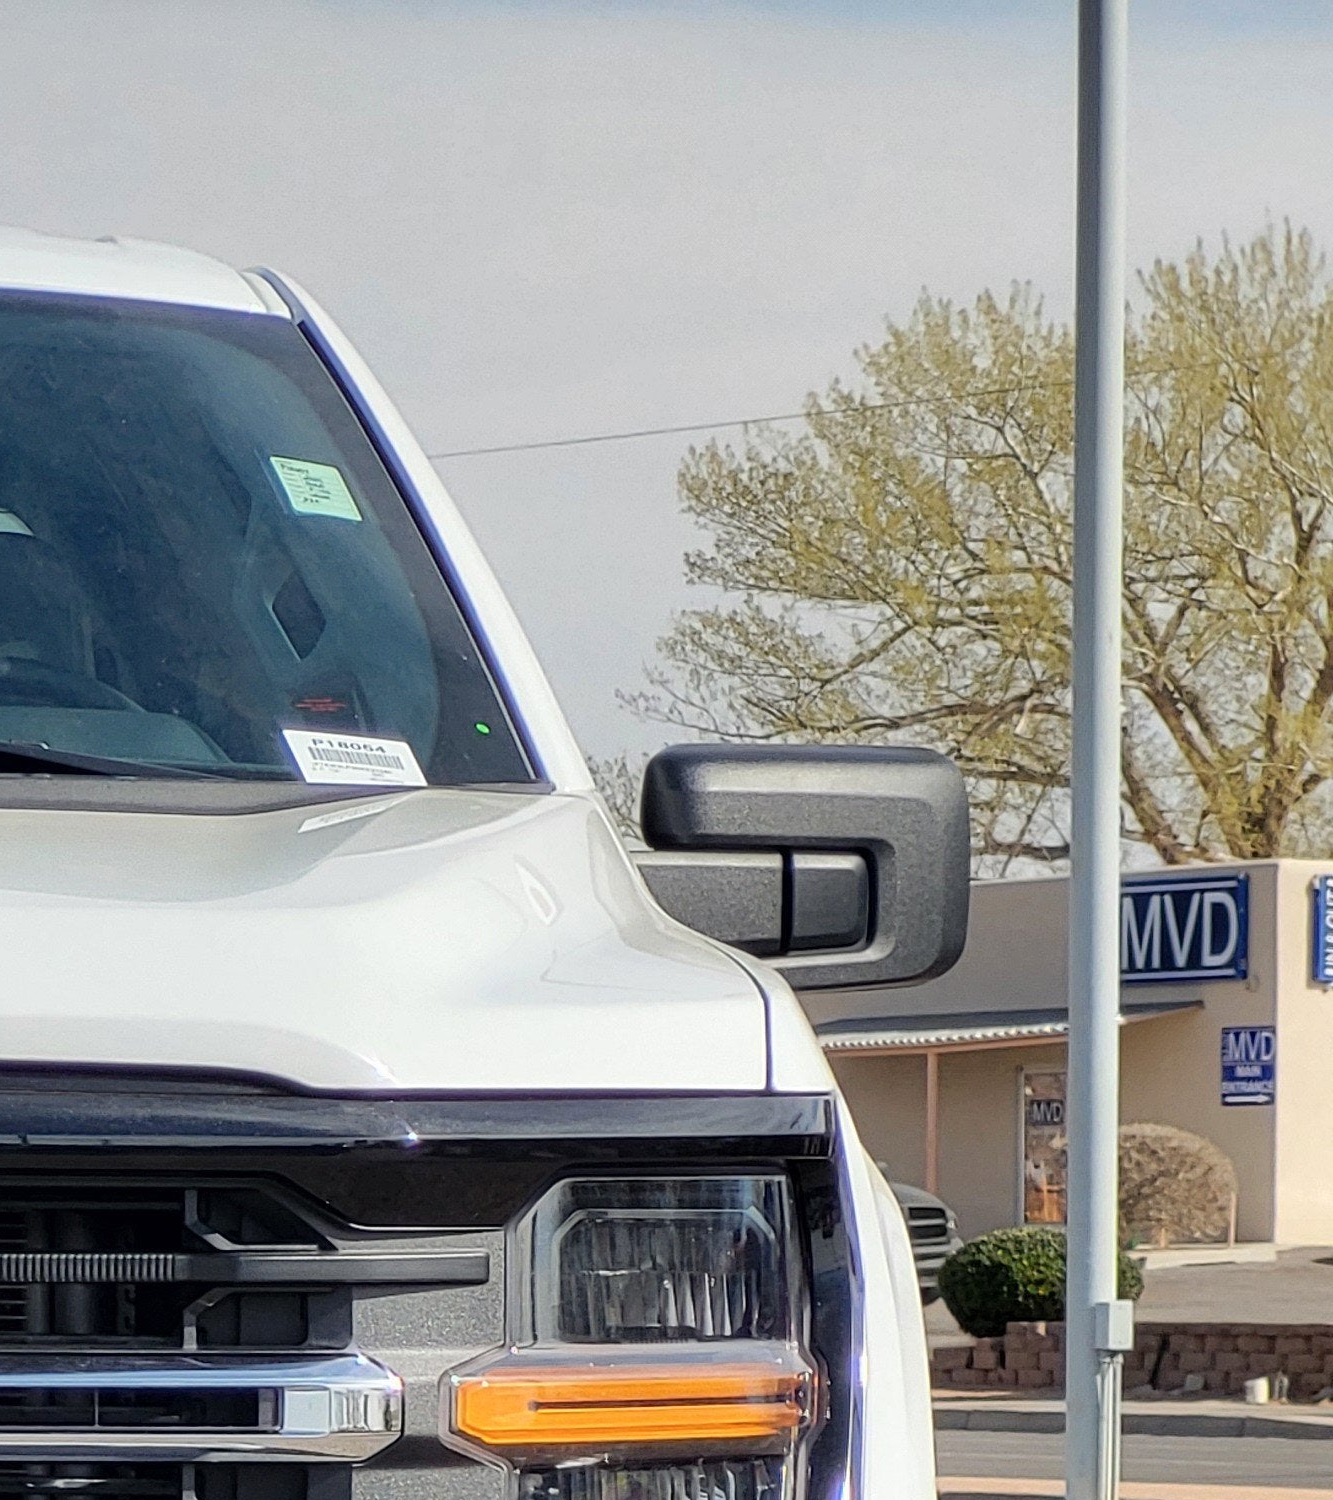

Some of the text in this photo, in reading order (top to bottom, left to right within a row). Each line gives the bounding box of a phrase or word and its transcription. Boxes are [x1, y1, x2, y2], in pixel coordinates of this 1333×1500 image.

[1121, 891, 1239, 970] MVD
[1228, 1031, 1276, 1061] MVD
[1033, 1101, 1062, 1122] MVD
